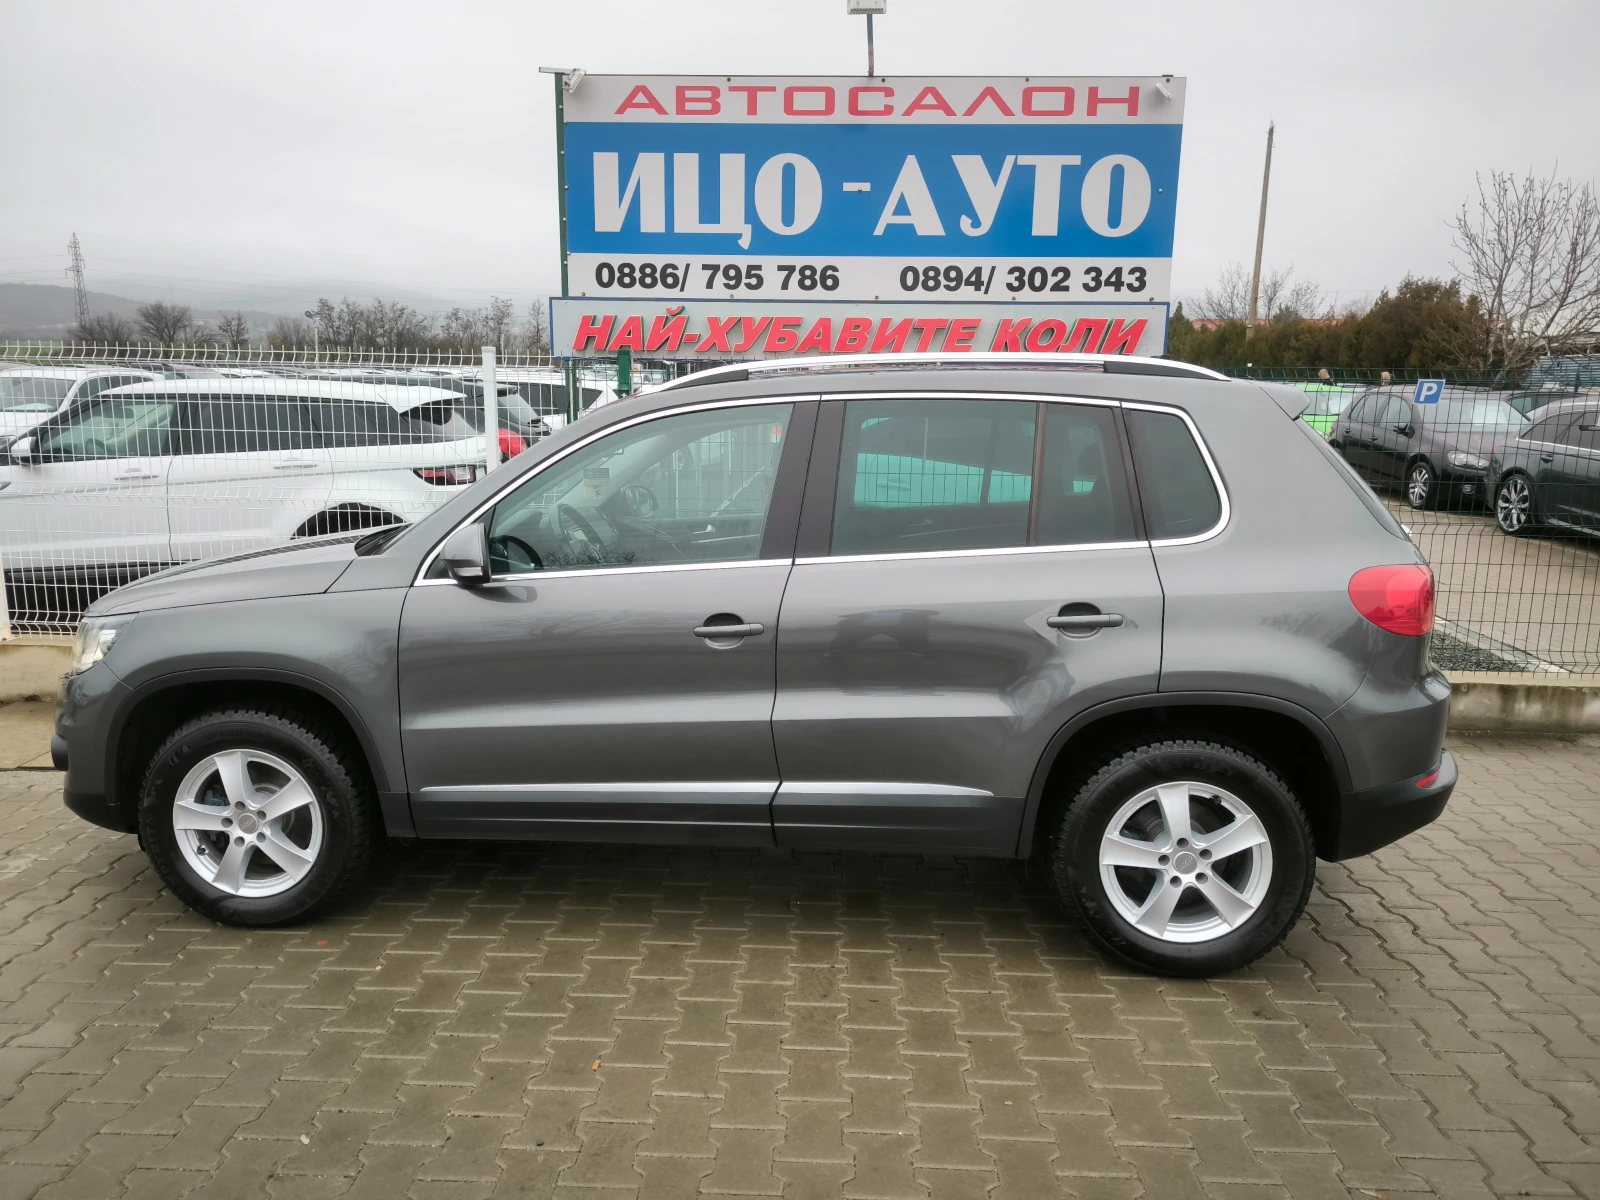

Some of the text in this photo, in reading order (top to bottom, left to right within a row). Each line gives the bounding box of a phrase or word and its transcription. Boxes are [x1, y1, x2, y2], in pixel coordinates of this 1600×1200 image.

[614, 85, 1140, 116] АВТОСАЛОН
[595, 262, 840, 292] 0886/ 795 786
[900, 265, 1147, 294] 0894/ 302 343
[572, 305, 1149, 354] НАЙ-ХУБАВИТЕ КОЛИ
[1419, 382, 1438, 402] P
